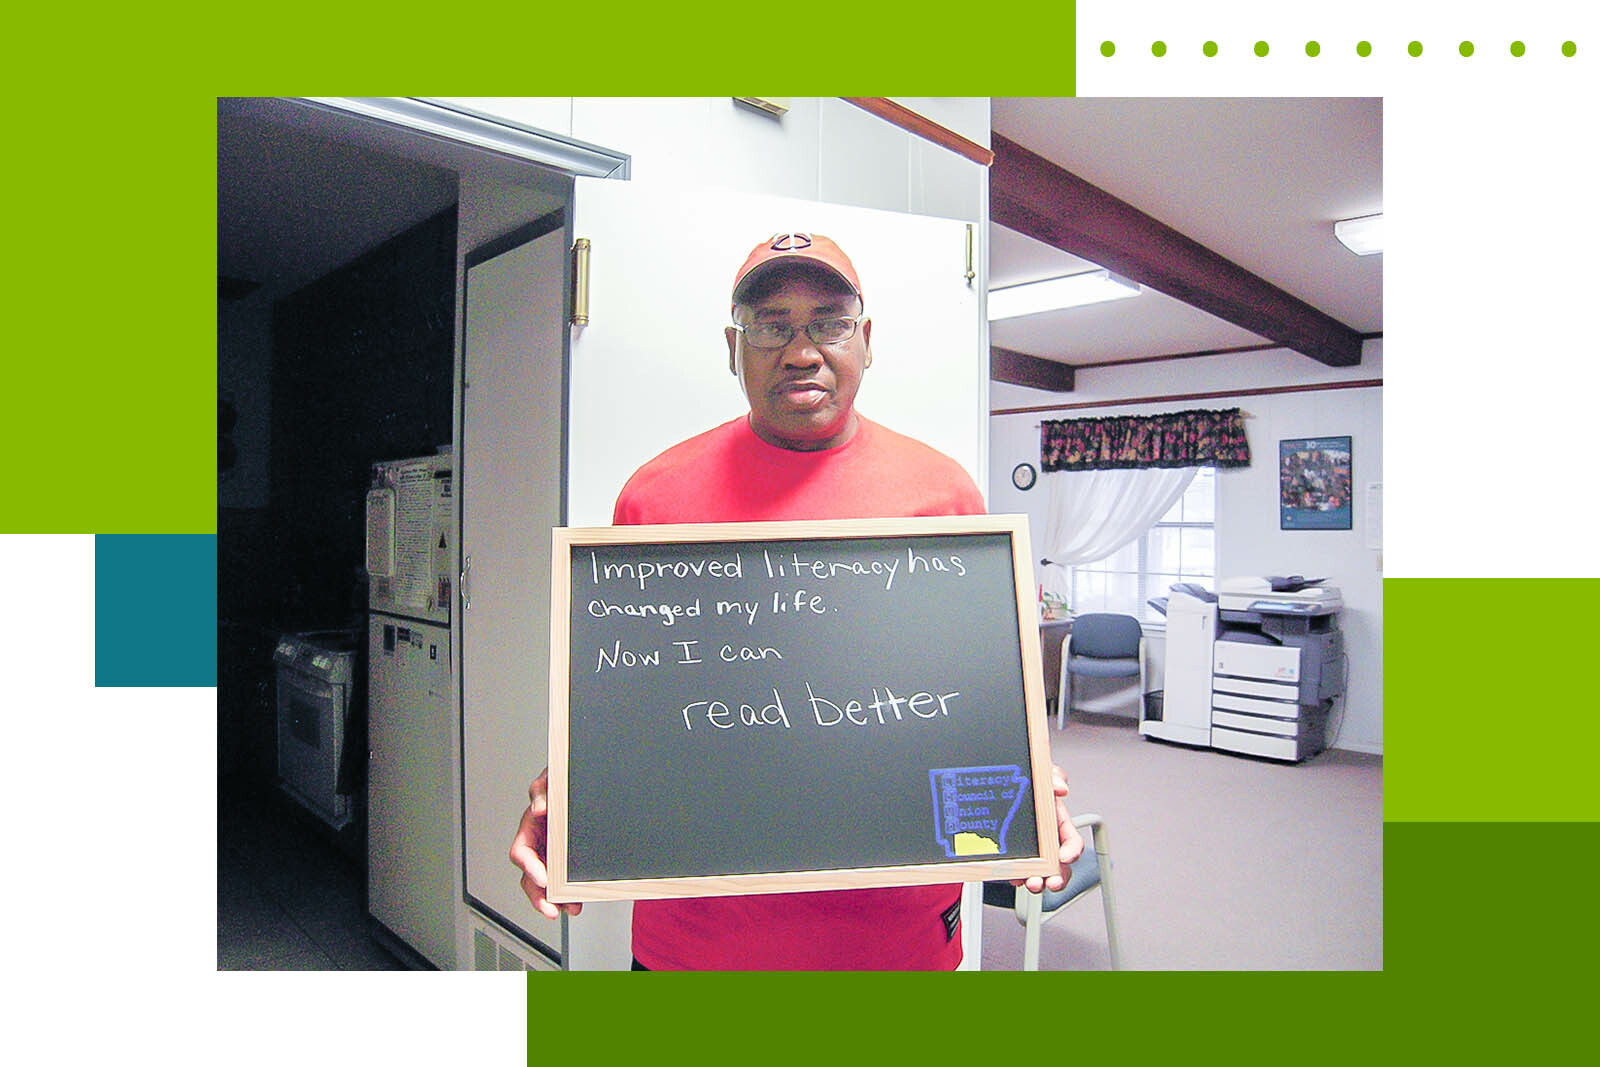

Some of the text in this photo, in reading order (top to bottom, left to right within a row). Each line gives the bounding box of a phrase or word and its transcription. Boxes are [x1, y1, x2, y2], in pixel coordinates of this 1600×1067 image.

[591, 547, 967, 590] Improved literacy has
[716, 601, 759, 626] my
[773, 590, 838, 614] life.
[595, 640, 783, 673] Now I can
[682, 681, 960, 731] read better
